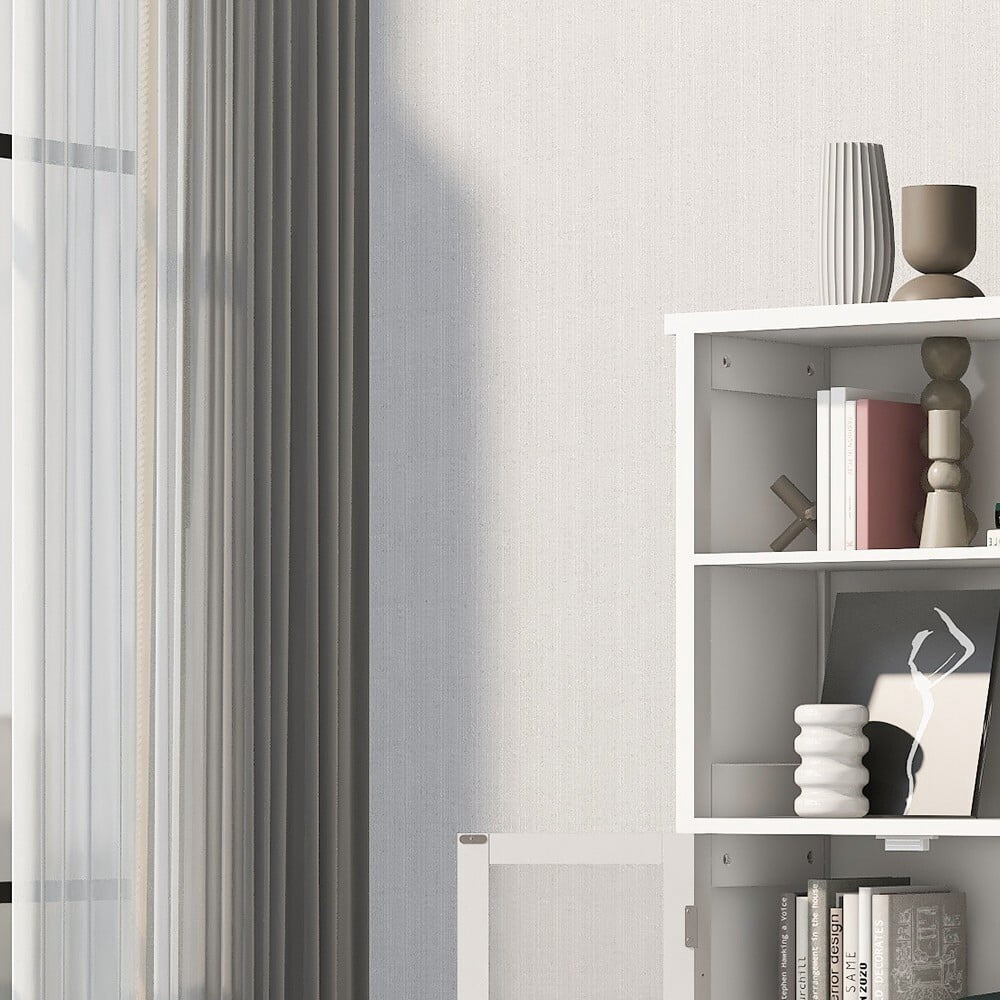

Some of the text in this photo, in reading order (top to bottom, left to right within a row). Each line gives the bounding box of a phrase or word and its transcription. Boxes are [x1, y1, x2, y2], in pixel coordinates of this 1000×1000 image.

[780, 896, 788, 921] Voice
[811, 883, 819, 908] house
[811, 912, 819, 927] the
[781, 934, 789, 968] Hawking
[830, 913, 843, 964] design
[874, 919, 884, 983] DECORATES
[811, 946, 821, 1000] arrangement
[845, 951, 857, 993] SAME
[859, 962, 868, 993] 2020
